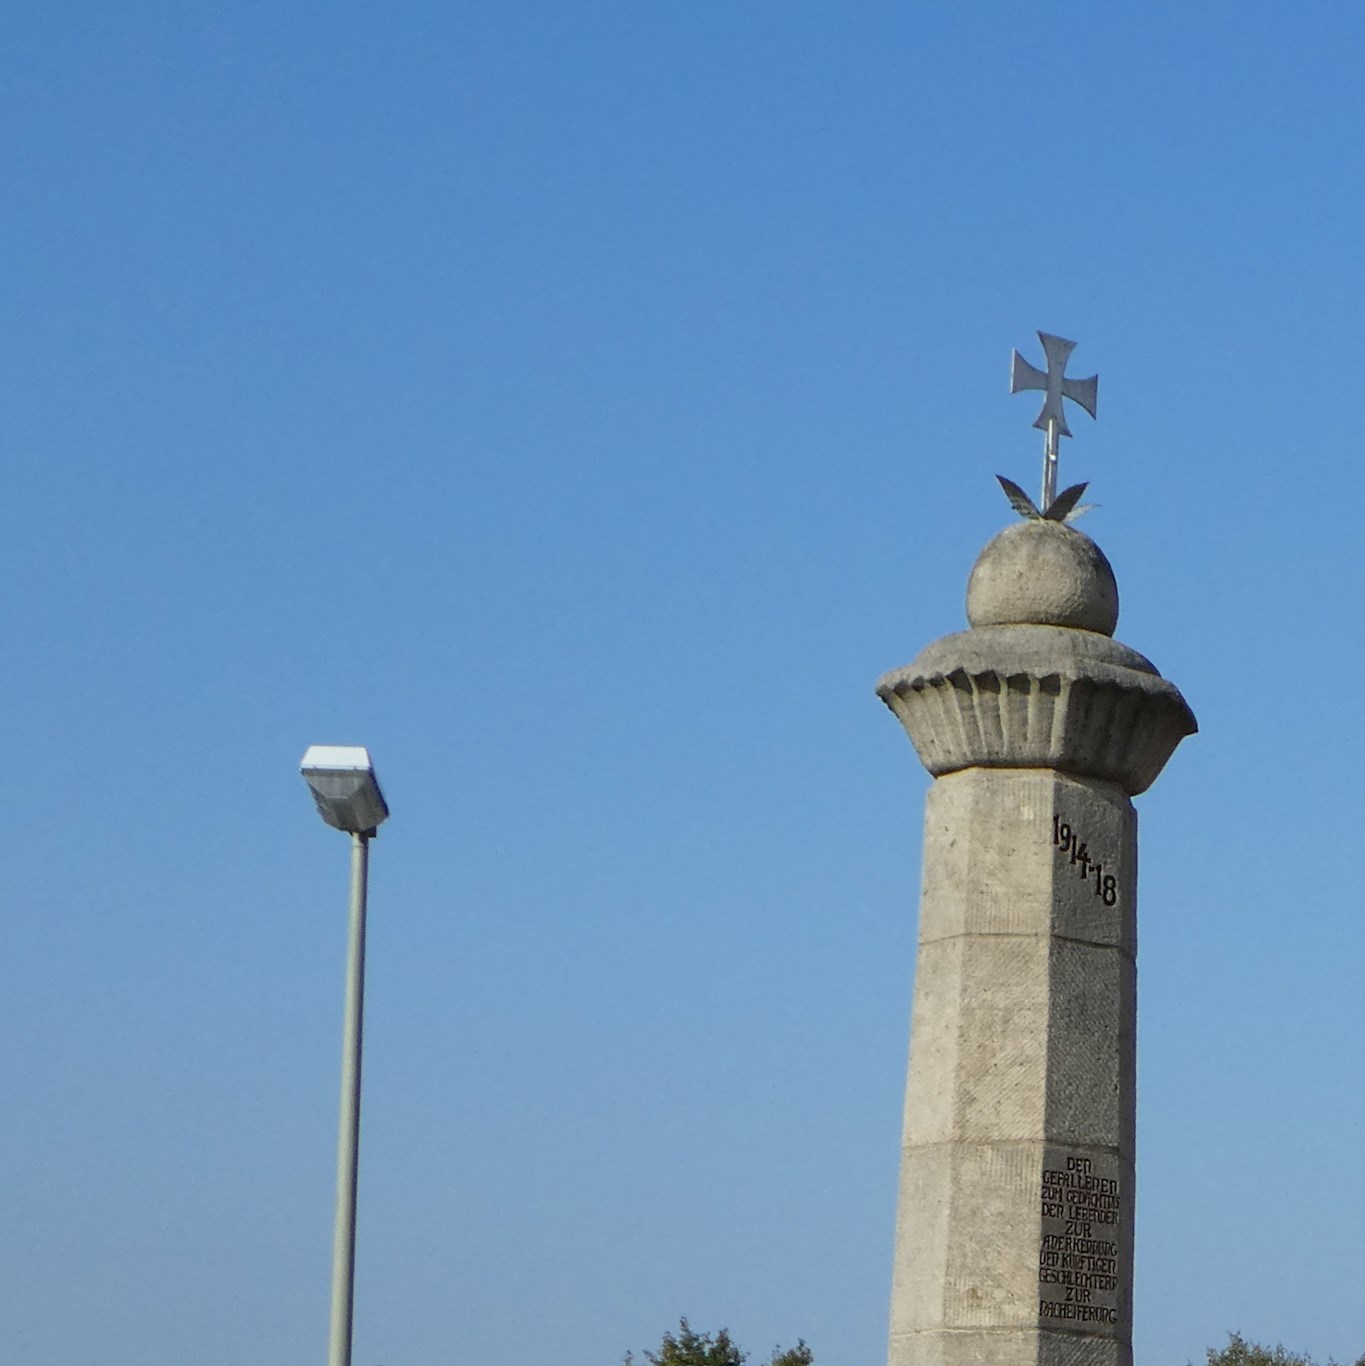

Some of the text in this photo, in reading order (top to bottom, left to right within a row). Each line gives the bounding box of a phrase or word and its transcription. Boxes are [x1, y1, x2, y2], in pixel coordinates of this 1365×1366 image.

[1053, 814, 1116, 906] 1914-18
[1067, 1157, 1091, 1174] DEN
[1044, 1170, 1117, 1194] GEFALLENEN
[1041, 1186, 1062, 1202] ZUM
[1042, 1203, 1119, 1224] DEN LEBENDEN
[1065, 1221, 1092, 1237] ZUR
[1043, 1234, 1117, 1257] ANERKENNUNG
[1040, 1251, 1058, 1267] DEN
[1066, 1287, 1091, 1303] ZUR
[1040, 1300, 1117, 1324] NACHEIFERUNG
